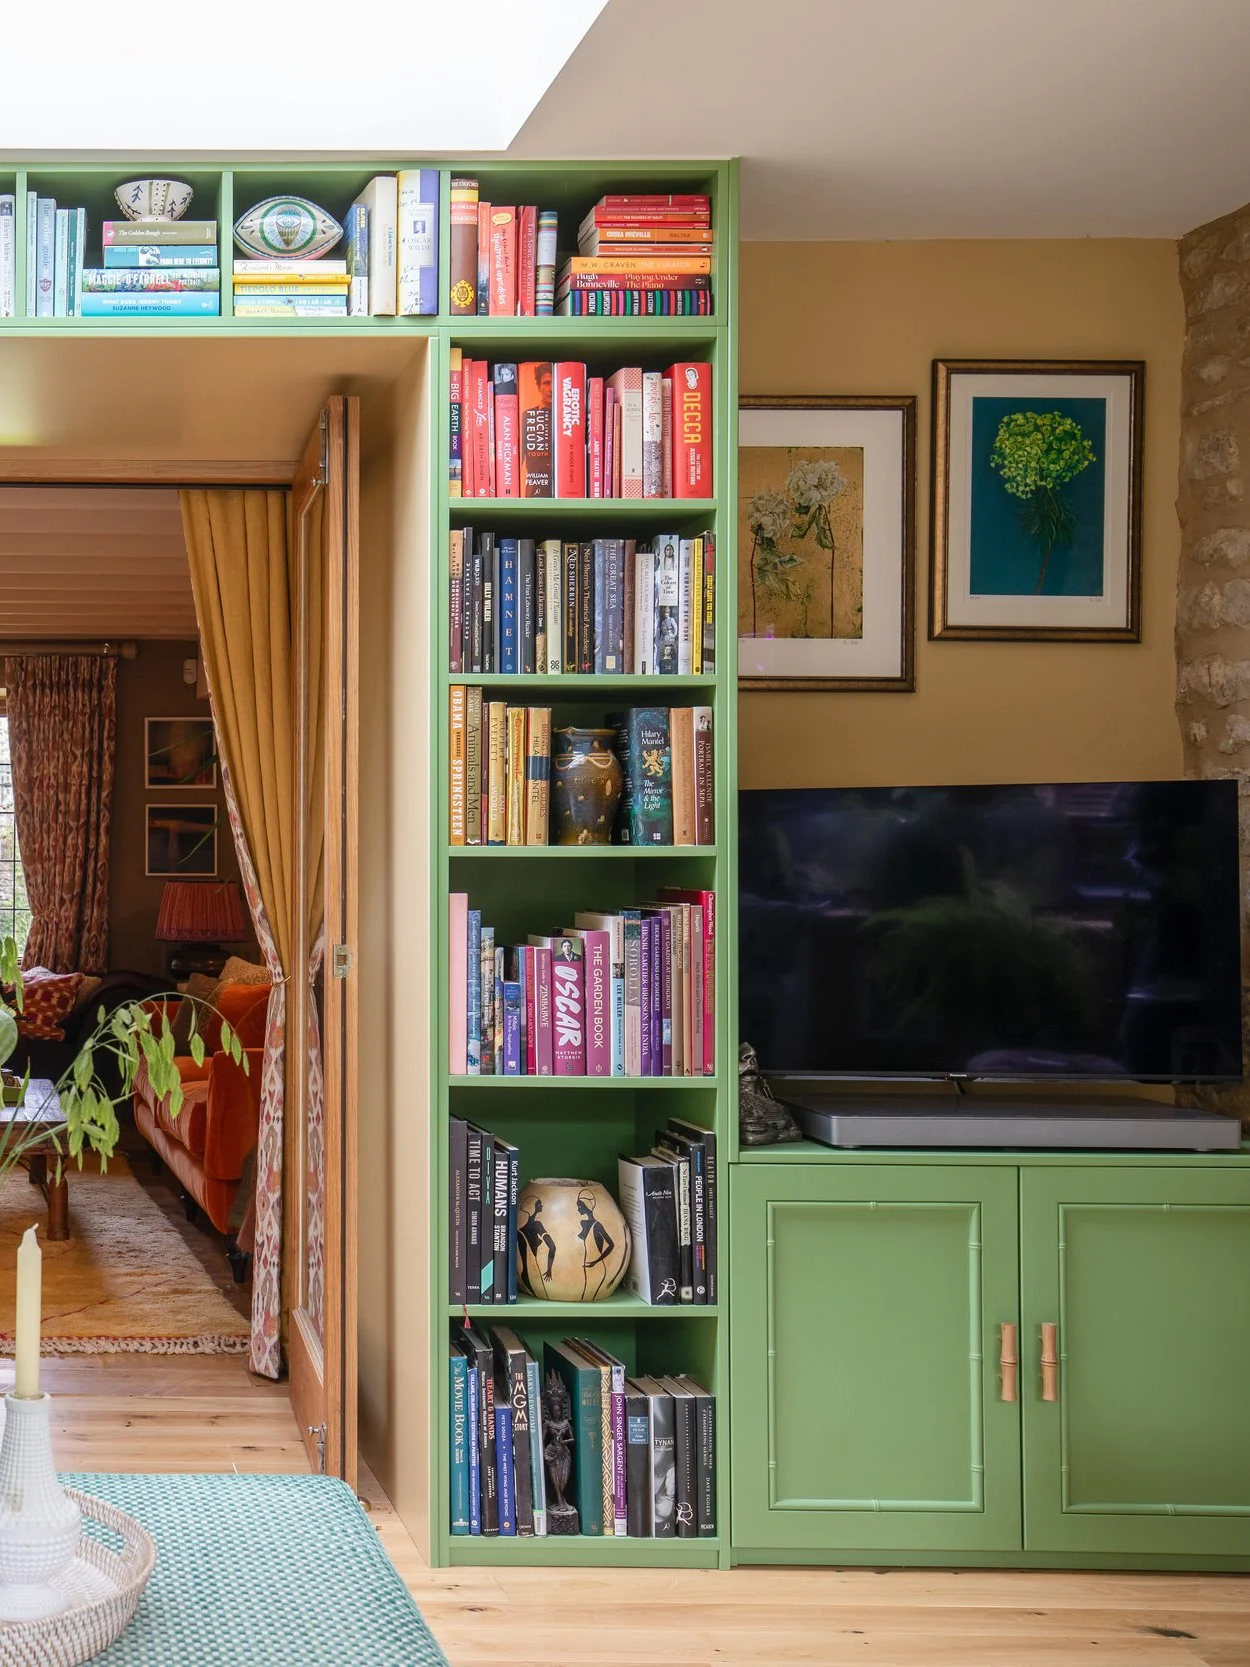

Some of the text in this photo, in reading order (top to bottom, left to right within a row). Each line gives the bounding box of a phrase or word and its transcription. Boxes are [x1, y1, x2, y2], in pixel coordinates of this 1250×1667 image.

[625, 274, 655, 282] Playing
[451, 383, 459, 400] BIG
[451, 404, 459, 432] EARTH
[562, 377, 572, 437] VAGRANCY
[571, 388, 580, 425] EROTIC
[683, 392, 702, 444] DECCA
[503, 416, 511, 485] ALAN RICKMAN
[526, 410, 535, 451] FREUD
[536, 410, 545, 451] LUCIAN
[567, 549, 576, 569] NED
[452, 691, 463, 836] OBAMA SPRINGSTEEN
[467, 724, 479, 824] Animals and Men
[554, 965, 582, 1047] OSCAR
[593, 944, 603, 1049] THE GARDEN BOOK
[468, 1139, 481, 1202] TIME TO ACT
[494, 1160, 508, 1217] HUMANS
[694, 1175, 704, 1242] PEOPLE IN LONDON
[453, 1376, 464, 1446] MOVIE BOOK
[486, 1378, 494, 1404] HEART
[487, 1413, 495, 1440] HANDS
[615, 1395, 624, 1475] JOHN SINGER SARGENT
